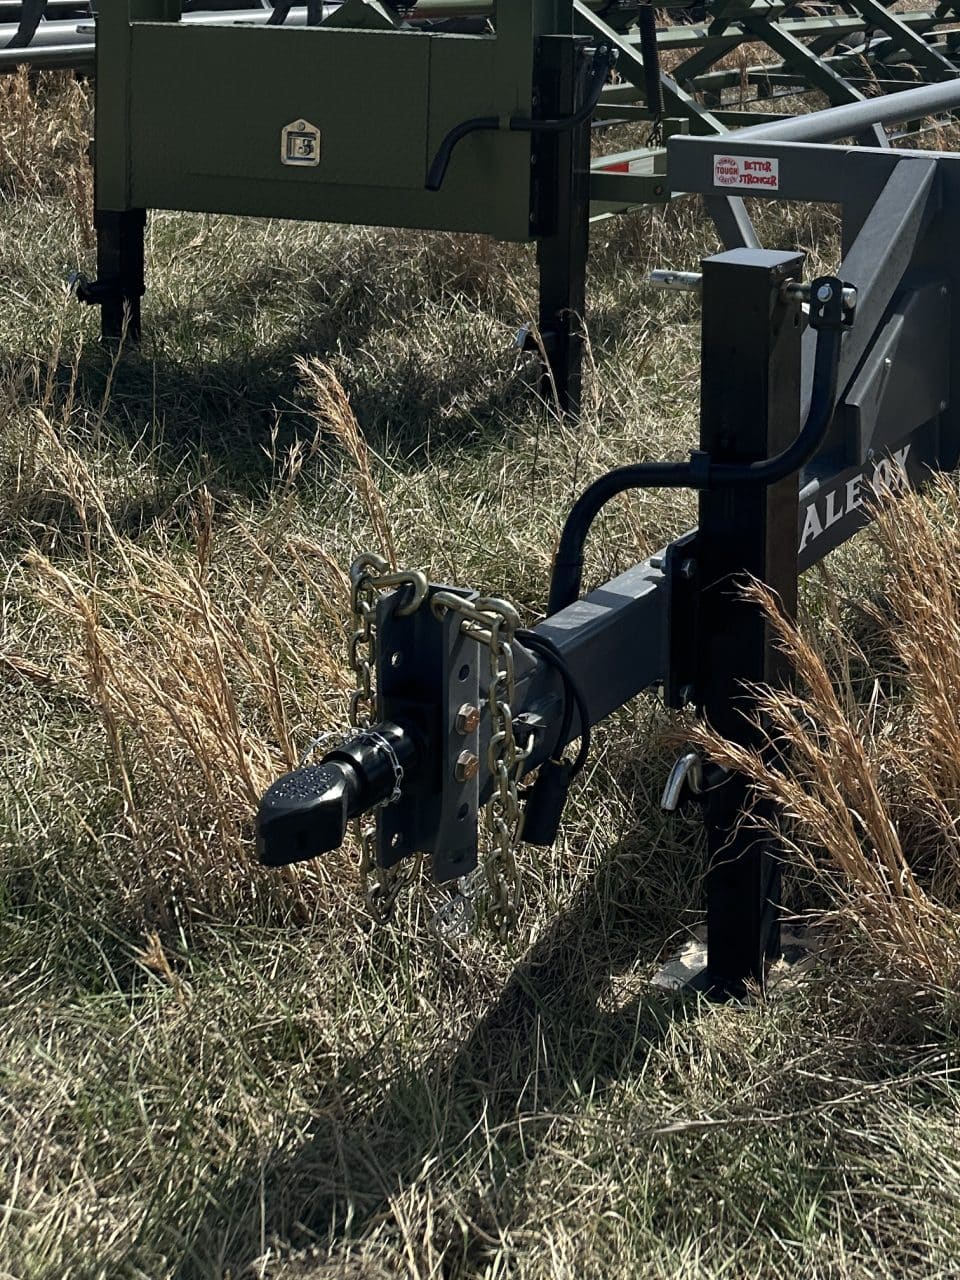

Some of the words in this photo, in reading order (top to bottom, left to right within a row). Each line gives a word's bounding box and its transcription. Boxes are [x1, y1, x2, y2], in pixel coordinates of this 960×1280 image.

[716, 166, 738, 175] TOUGH
[744, 160, 772, 172] BETTER
[739, 173, 777, 186] STRONGER
